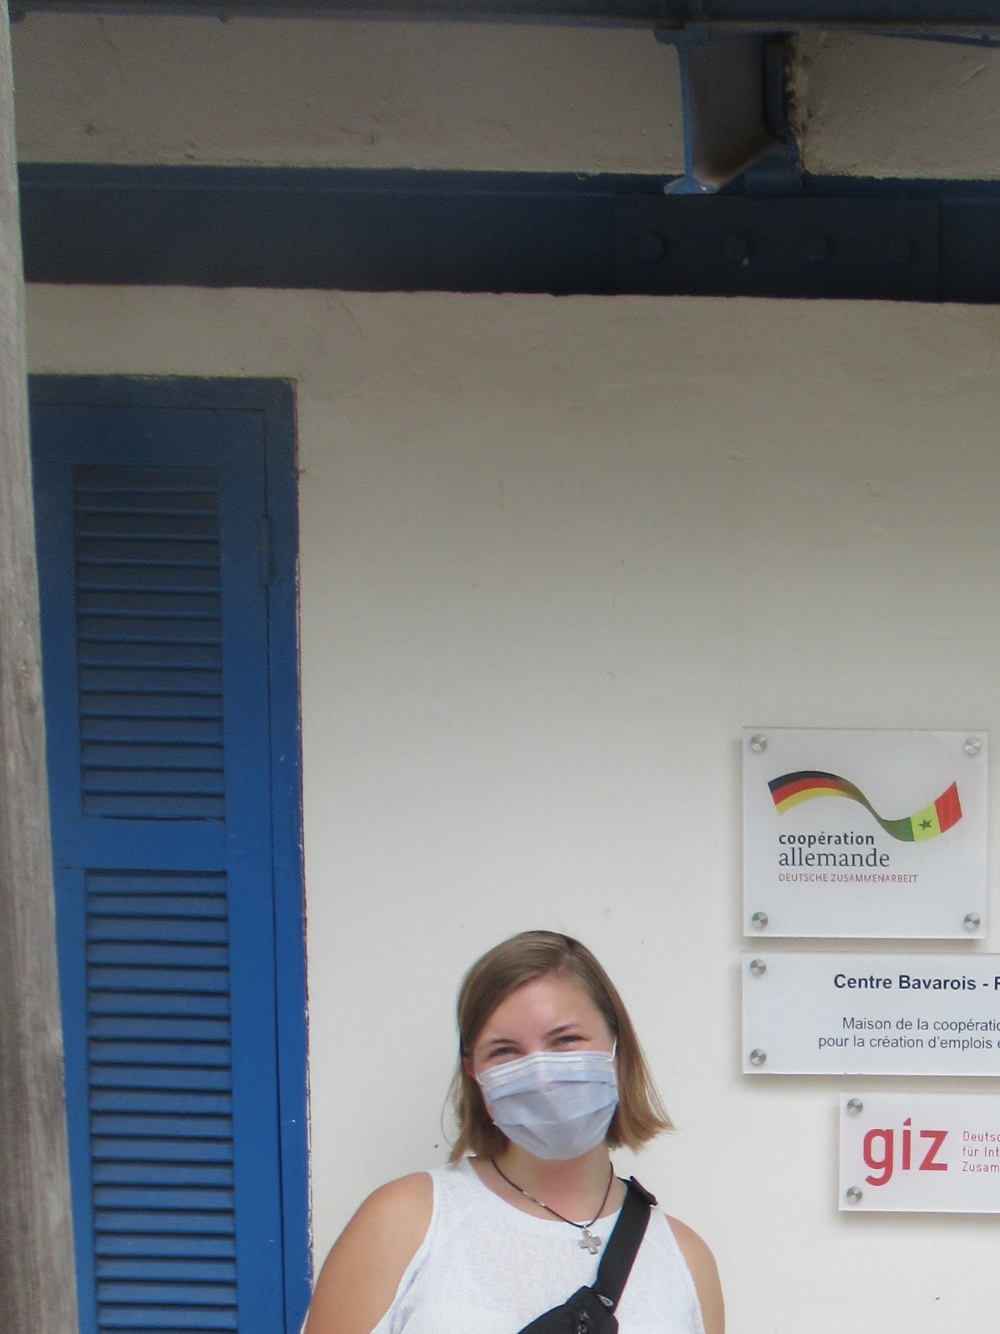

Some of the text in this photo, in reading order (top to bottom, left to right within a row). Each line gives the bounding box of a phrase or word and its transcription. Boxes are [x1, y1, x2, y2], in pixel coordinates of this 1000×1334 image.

[779, 832, 875, 849] coopération
[779, 848, 889, 867] allemande
[779, 874, 918, 882] DEUTSCHE ZUSAMMENARBEIT
[834, 974, 892, 989] Centre
[899, 975, 976, 990] Bavarois
[843, 1017, 890, 1029] Maison
[896, 1018, 911, 1030] de
[918, 1018, 928, 1030] la
[819, 1038, 849, 1049] pour
[854, 1035, 864, 1047] la
[870, 1036, 923, 1048] création
[928, 1036, 992, 1051] d'emplois
[863, 1118, 948, 1186] giz
[963, 1146, 978, 1156] für
